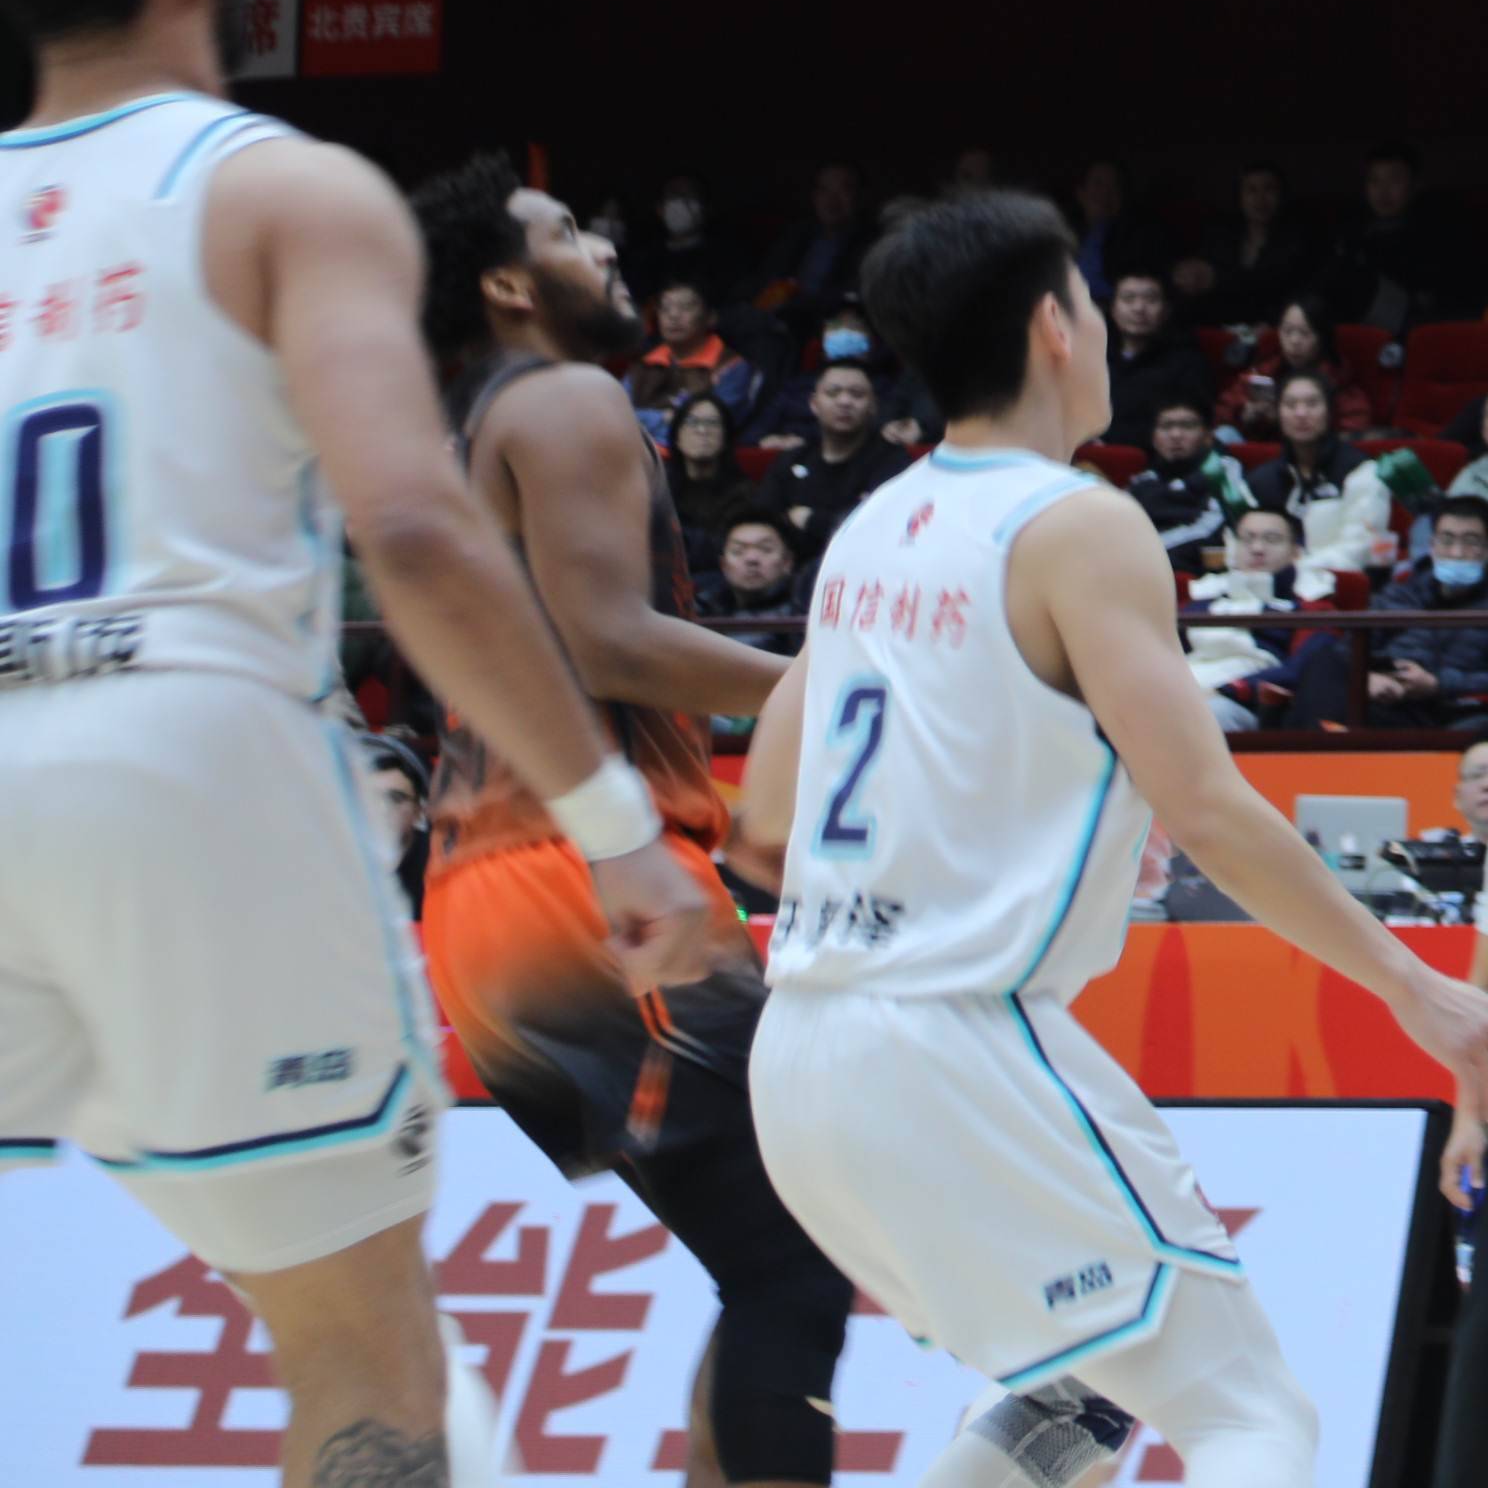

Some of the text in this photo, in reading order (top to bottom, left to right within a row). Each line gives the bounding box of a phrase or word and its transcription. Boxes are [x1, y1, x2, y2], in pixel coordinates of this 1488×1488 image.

[308, 1, 435, 43] 北贵宾席
[818, 681, 890, 850] 2
